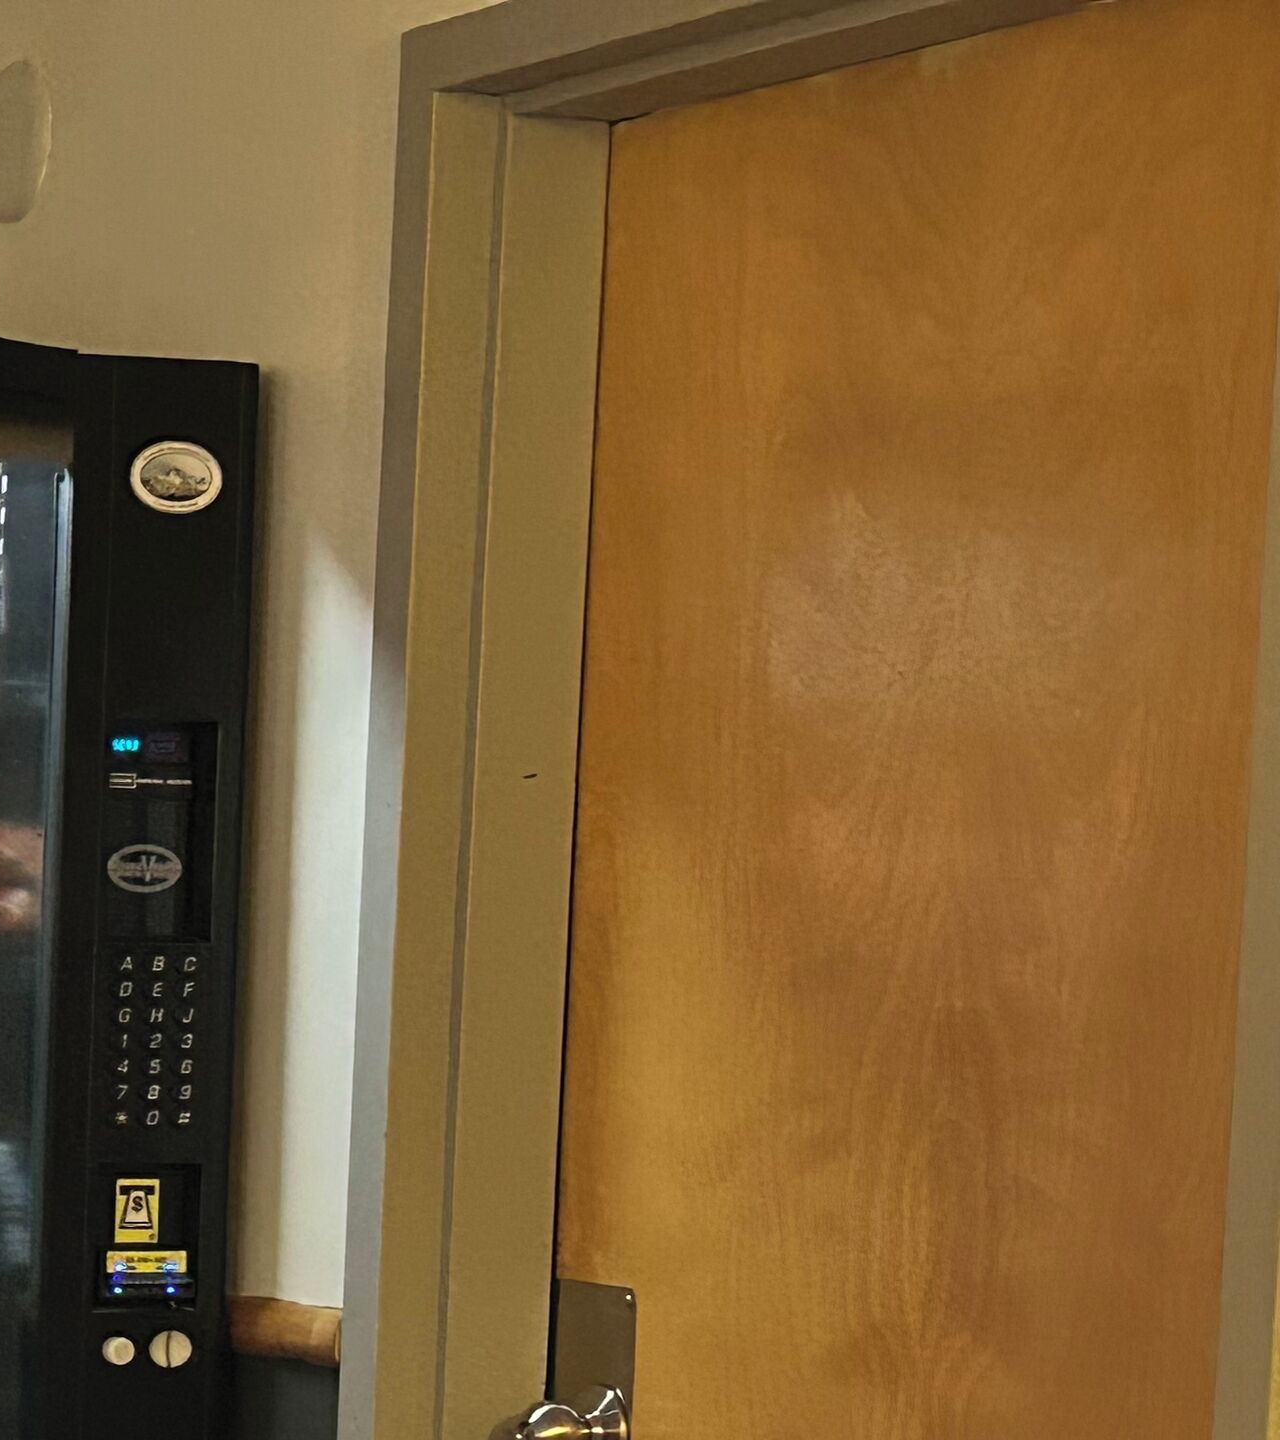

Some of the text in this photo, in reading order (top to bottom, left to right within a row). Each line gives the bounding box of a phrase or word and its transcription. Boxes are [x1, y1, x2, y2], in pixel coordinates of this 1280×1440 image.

[120, 956, 197, 972] A B C
[119, 982, 195, 997] D E F
[118, 1008, 194, 1023] G H J
[122, 1033, 193, 1049] 1 2 3
[117, 1059, 193, 1074] 4 5 6
[116, 1084, 192, 1100] 7 8 9
[146, 1110, 159, 1126] 0
